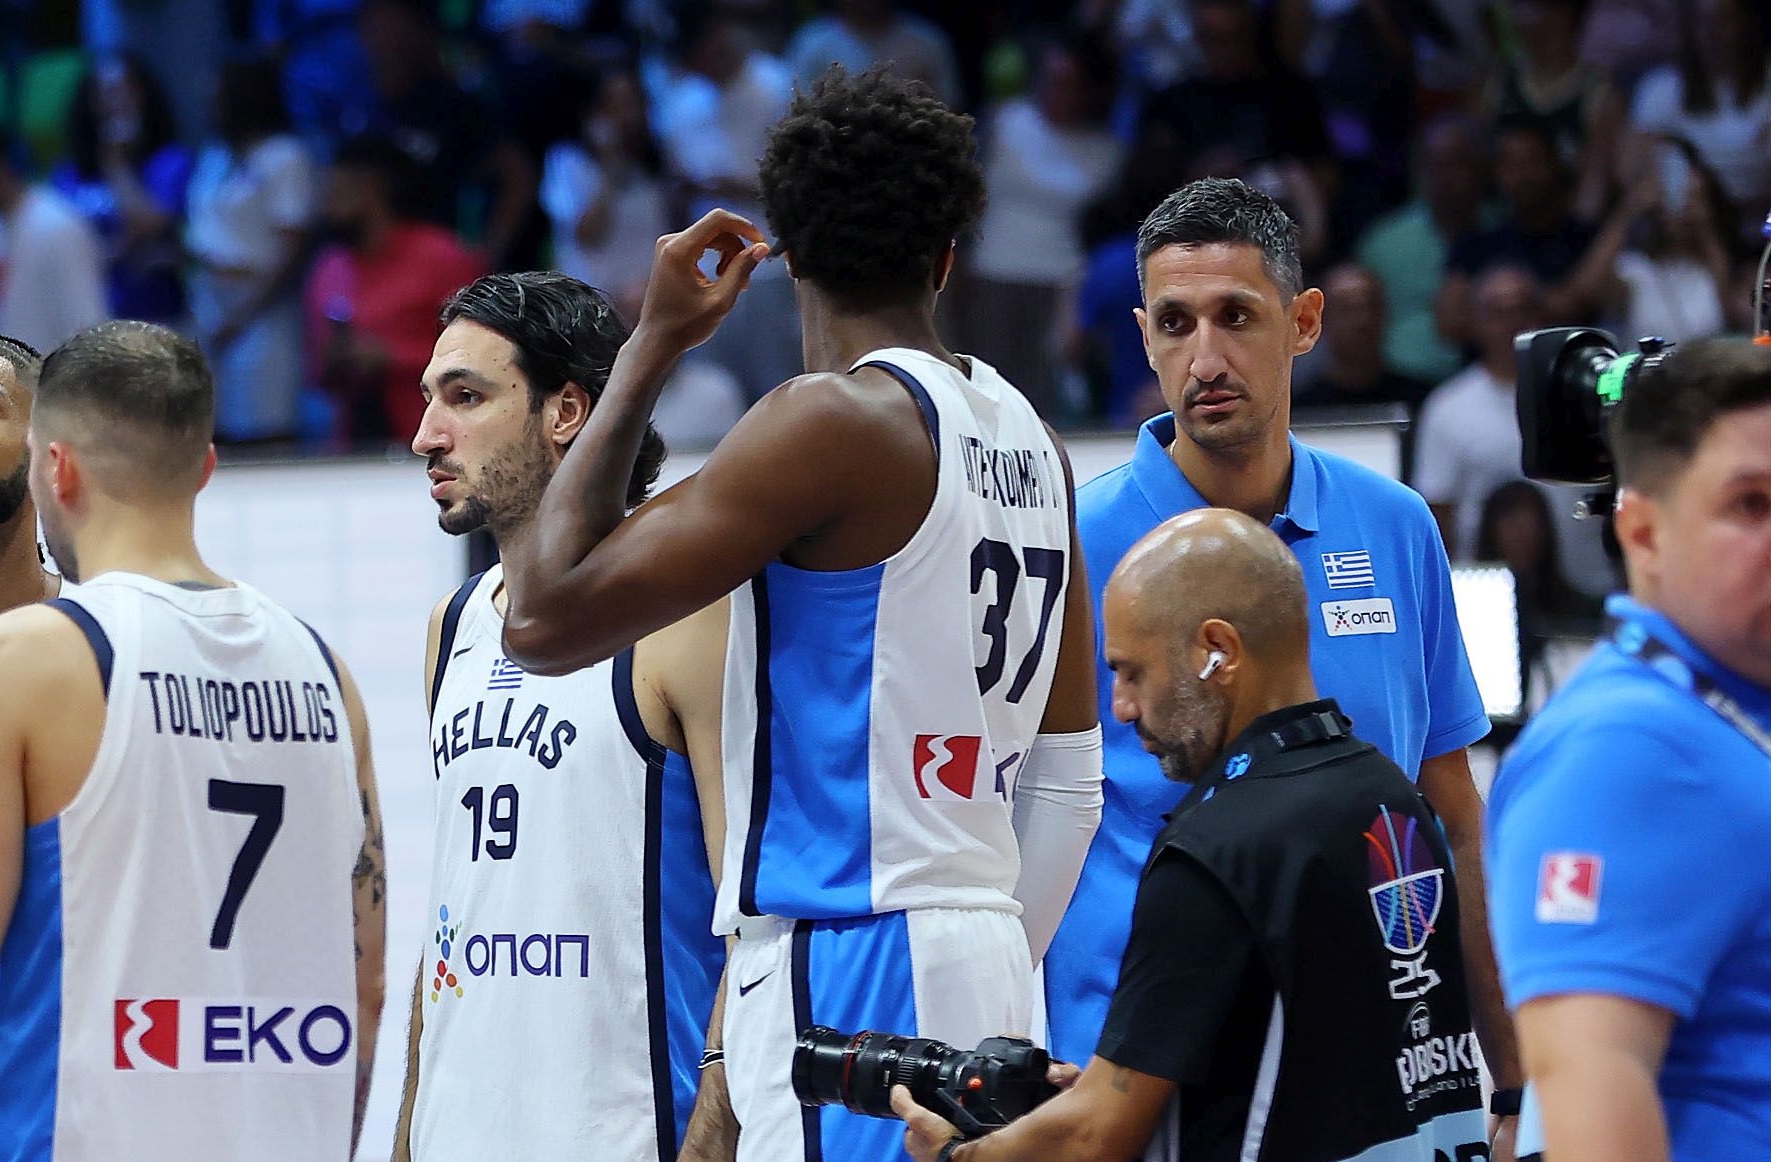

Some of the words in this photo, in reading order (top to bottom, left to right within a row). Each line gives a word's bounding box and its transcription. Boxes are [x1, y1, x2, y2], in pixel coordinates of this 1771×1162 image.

[970, 537, 1064, 704] 37
[139, 672, 338, 743] TOLIOPOULOS
[432, 698, 577, 780] HELLAS
[461, 783, 519, 862] 19
[207, 778, 285, 950] 7
[204, 1004, 351, 1066] EKO
